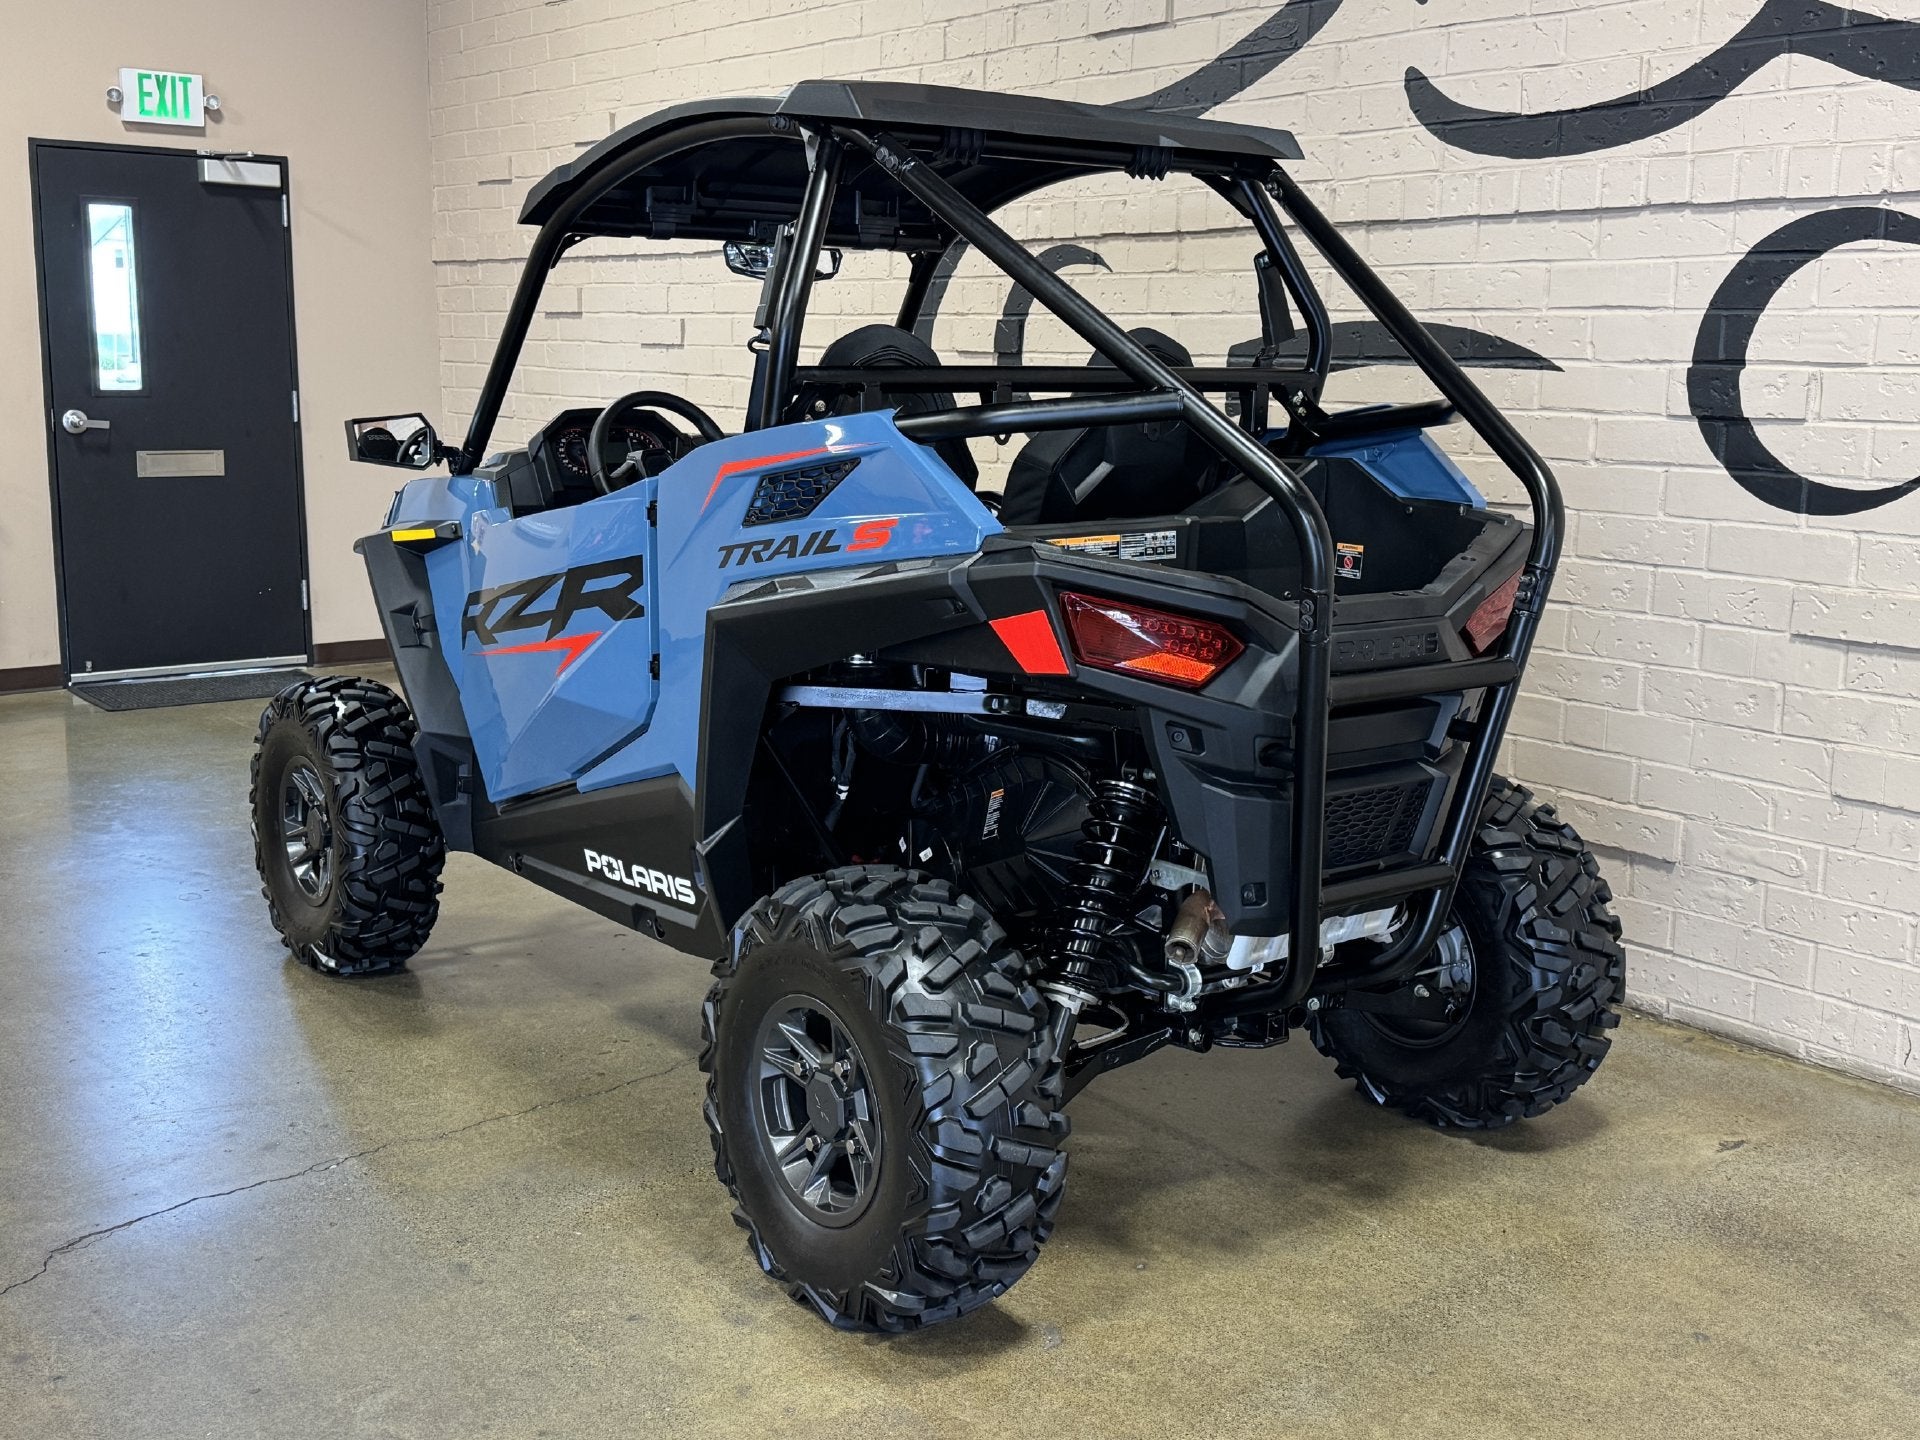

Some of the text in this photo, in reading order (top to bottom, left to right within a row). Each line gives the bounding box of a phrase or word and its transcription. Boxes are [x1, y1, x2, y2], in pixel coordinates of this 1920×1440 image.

[137, 72, 192, 120] EXIT
[718, 518, 899, 568] TRAIL S
[461, 554, 645, 651] RZR
[584, 848, 696, 905] POLARIS
